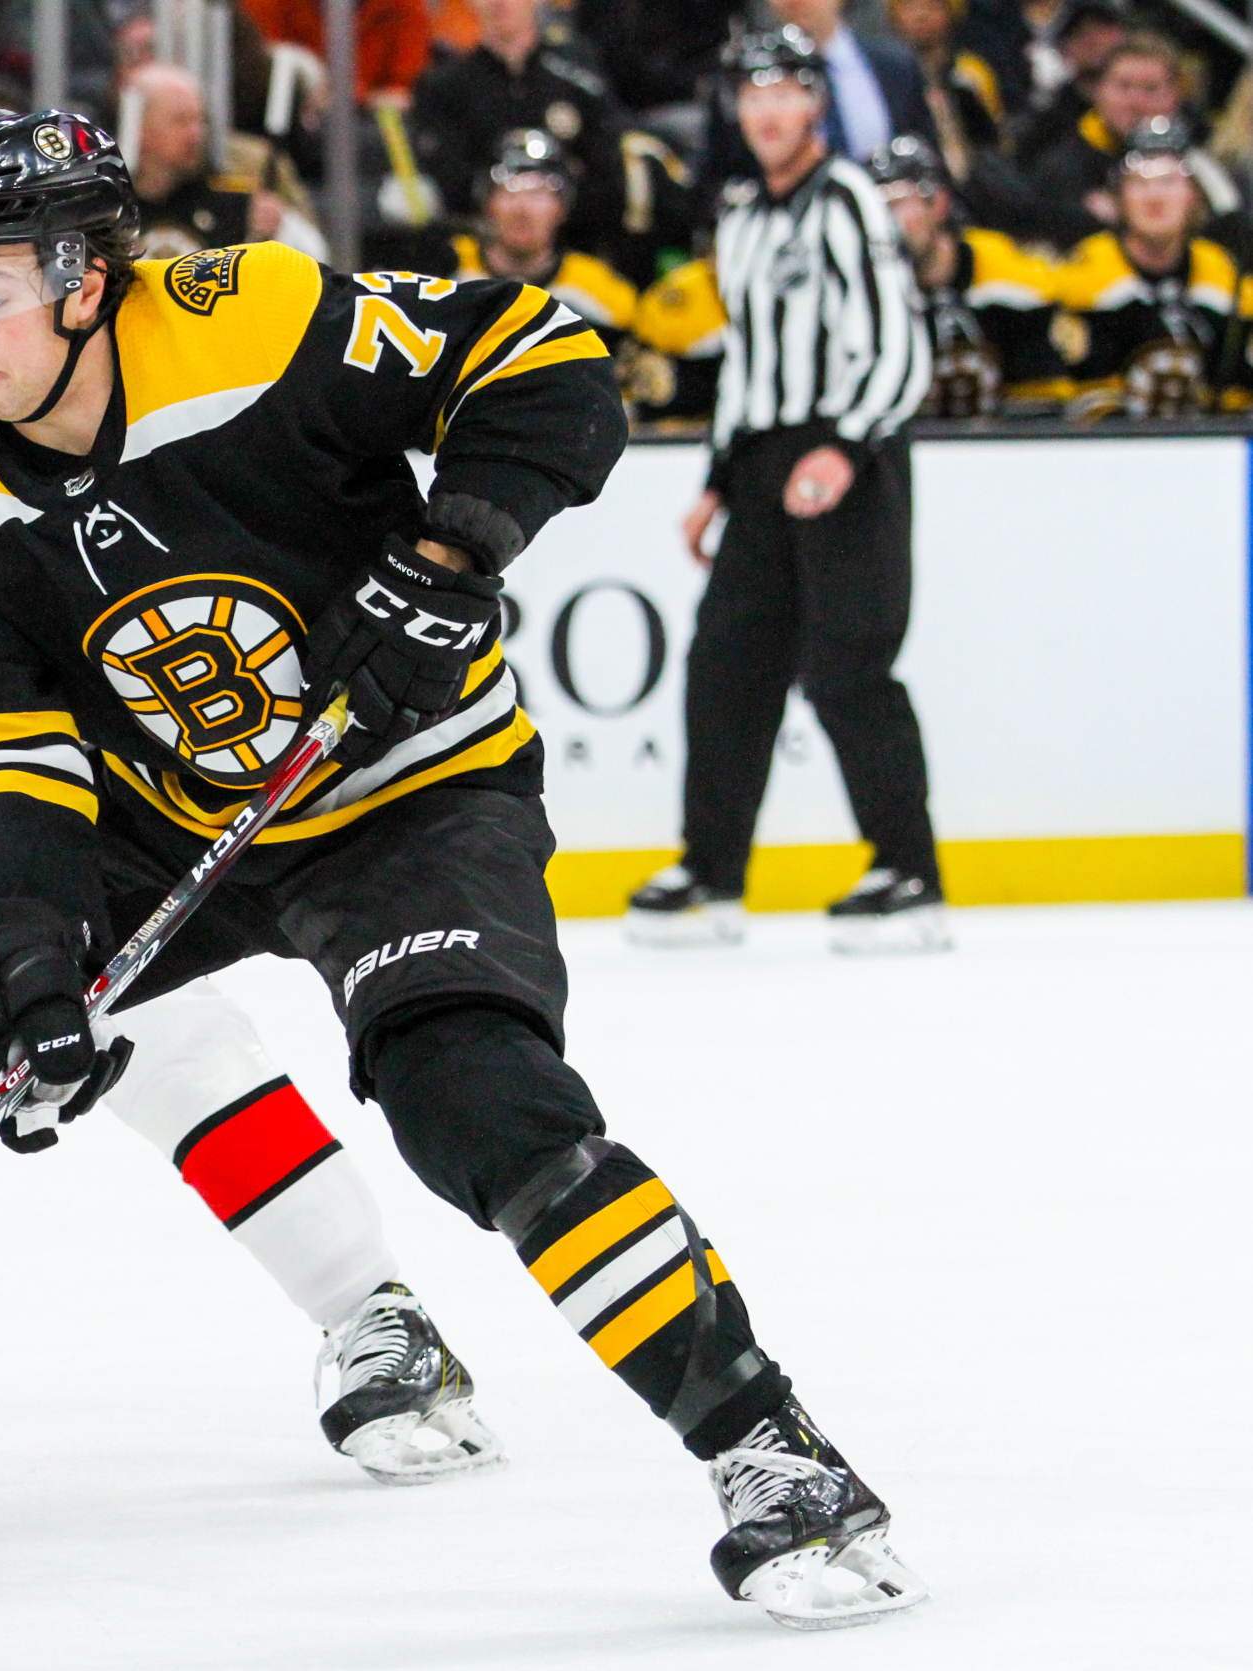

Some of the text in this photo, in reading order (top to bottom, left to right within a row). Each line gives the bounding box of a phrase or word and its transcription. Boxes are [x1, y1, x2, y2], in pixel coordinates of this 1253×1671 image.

[388, 554, 432, 586] MCAVOY 73
[124, 627, 272, 752] B
[191, 806, 259, 883] CCM
[343, 929, 480, 1007] BAUER
[38, 1033, 81, 1053] CCM
